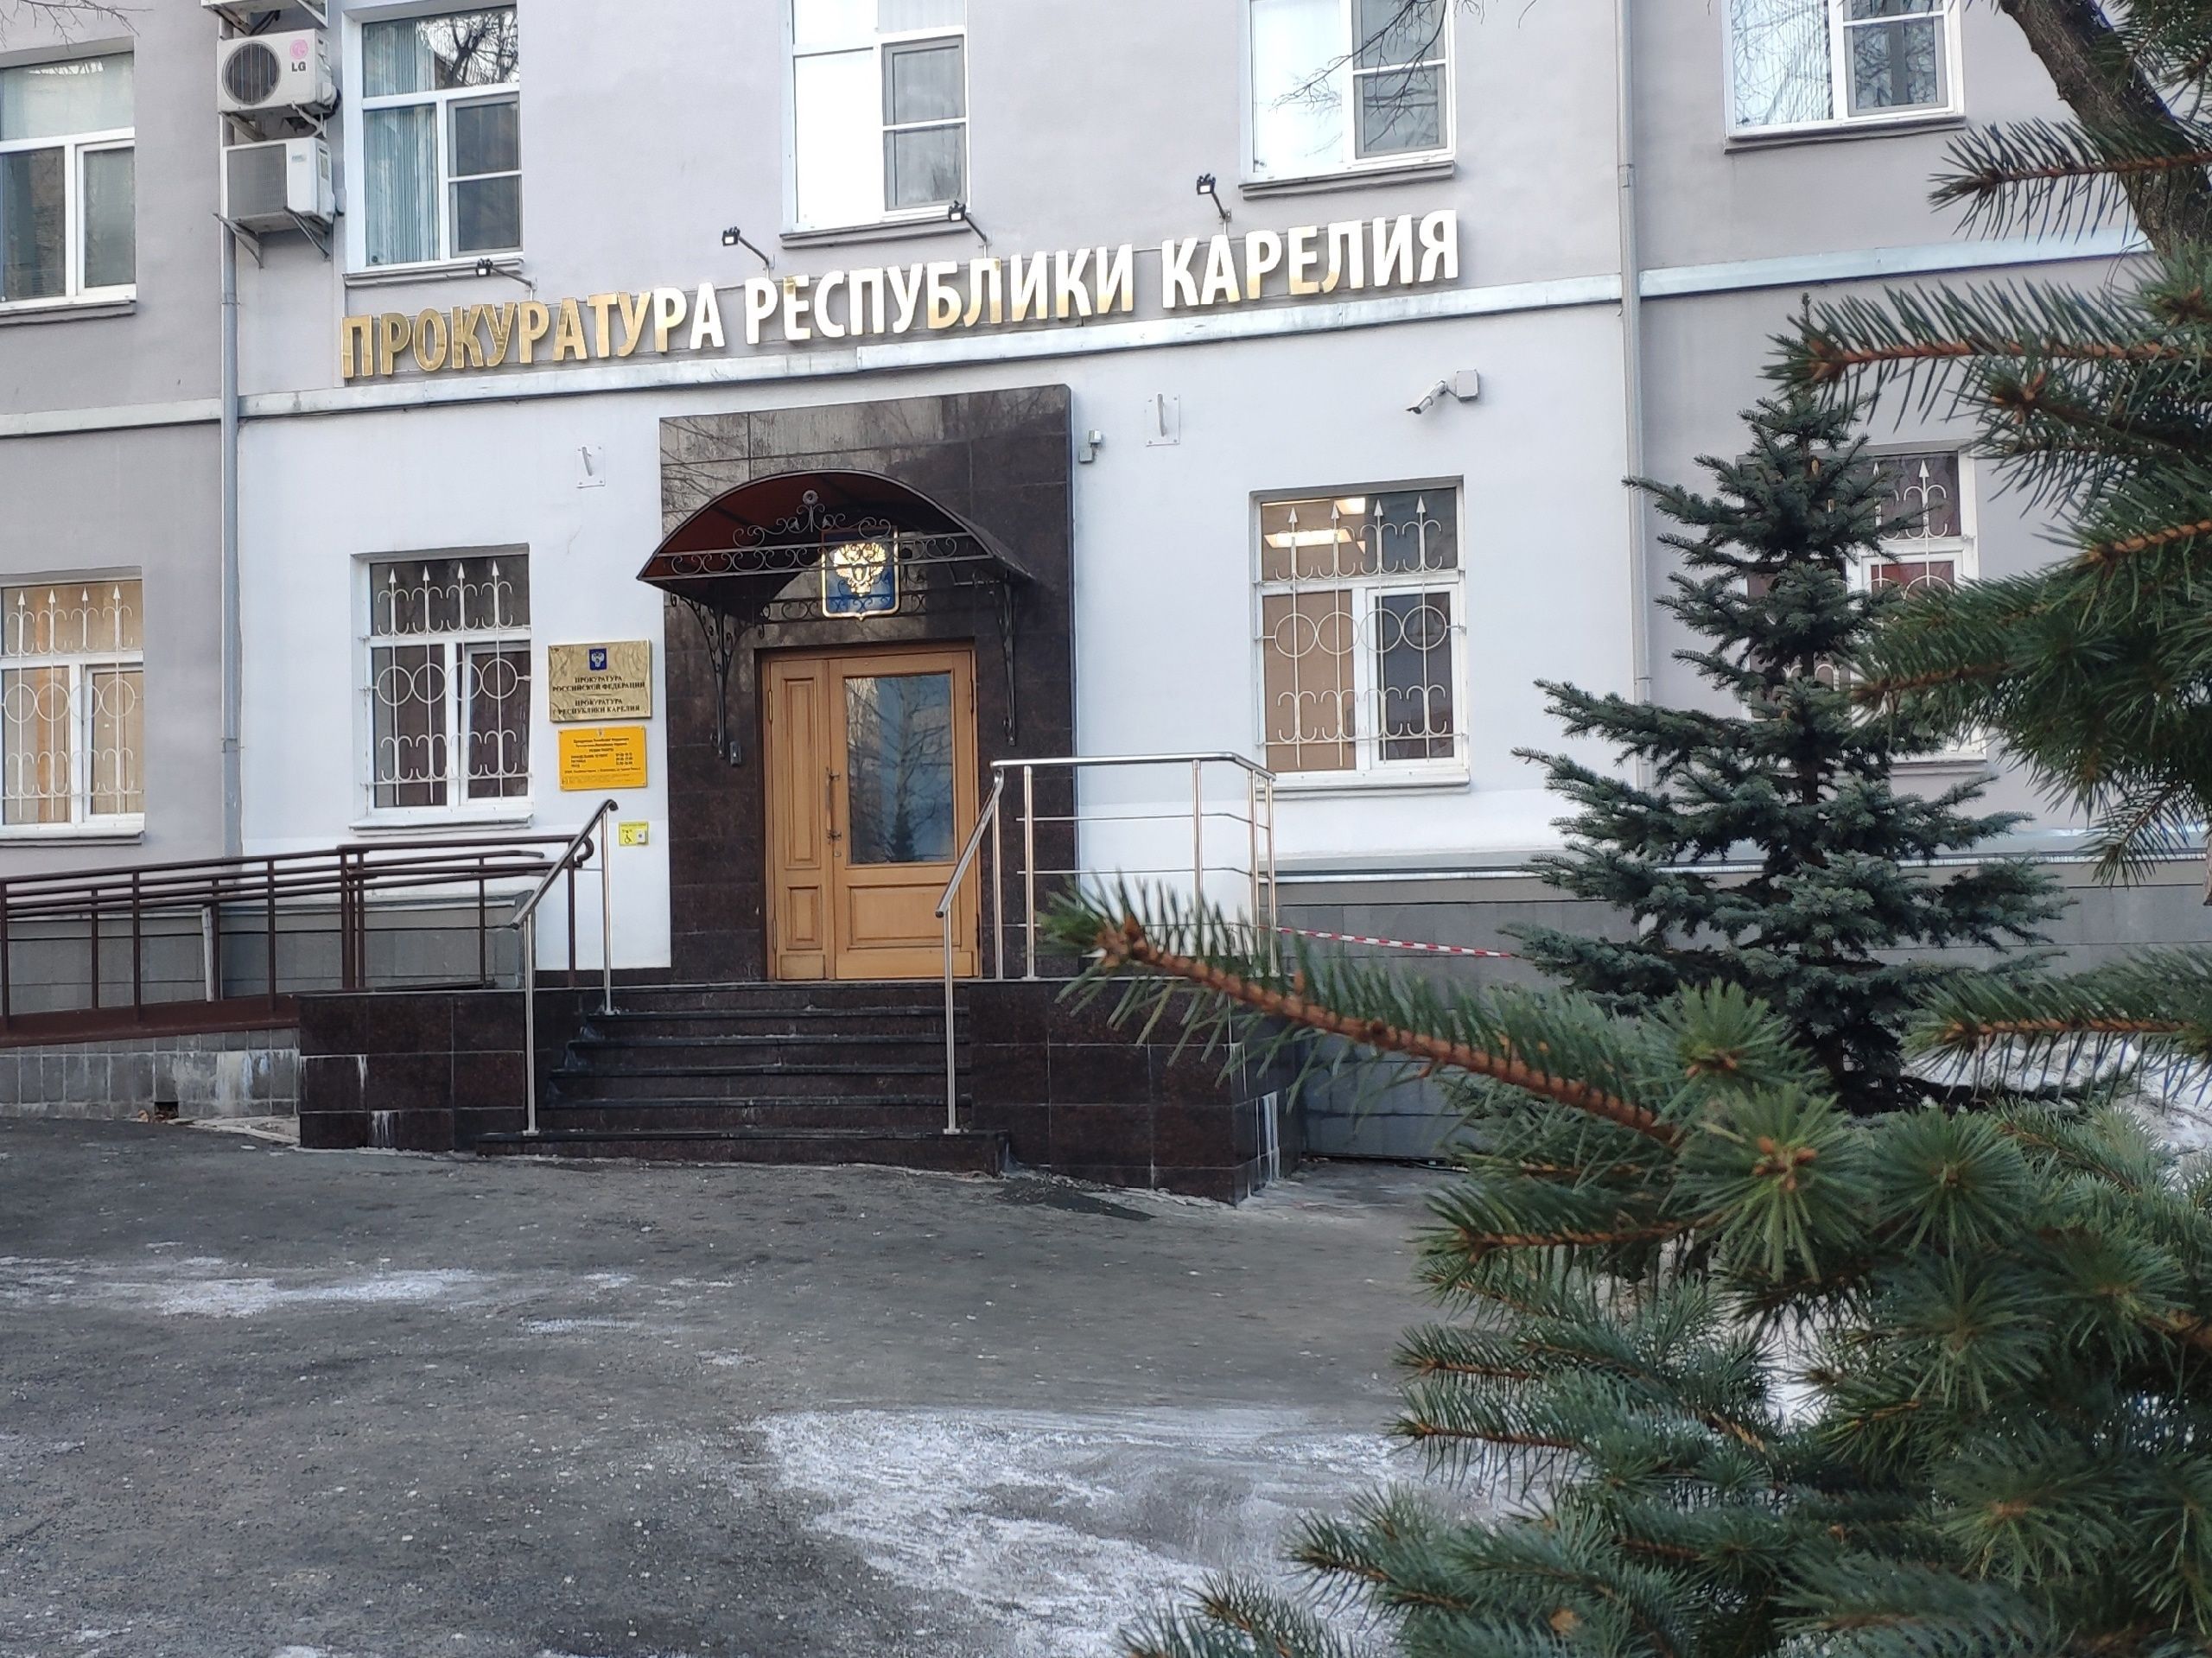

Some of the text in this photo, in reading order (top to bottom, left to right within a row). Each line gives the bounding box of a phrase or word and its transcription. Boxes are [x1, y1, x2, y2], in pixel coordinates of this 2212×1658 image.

[291, 60, 307, 73] LG
[340, 208, 1460, 379] ПРОКУРАТУРА РЕСПУБЛИКИ КАРЕЛИЯ
[575, 675, 623, 683] ПРОКУРАТУРА
[552, 681, 645, 692] РОССИЙСКОЙ ФЕДЕРАЦИИ
[575, 698, 623, 707] ПРОКУРАТУРА
